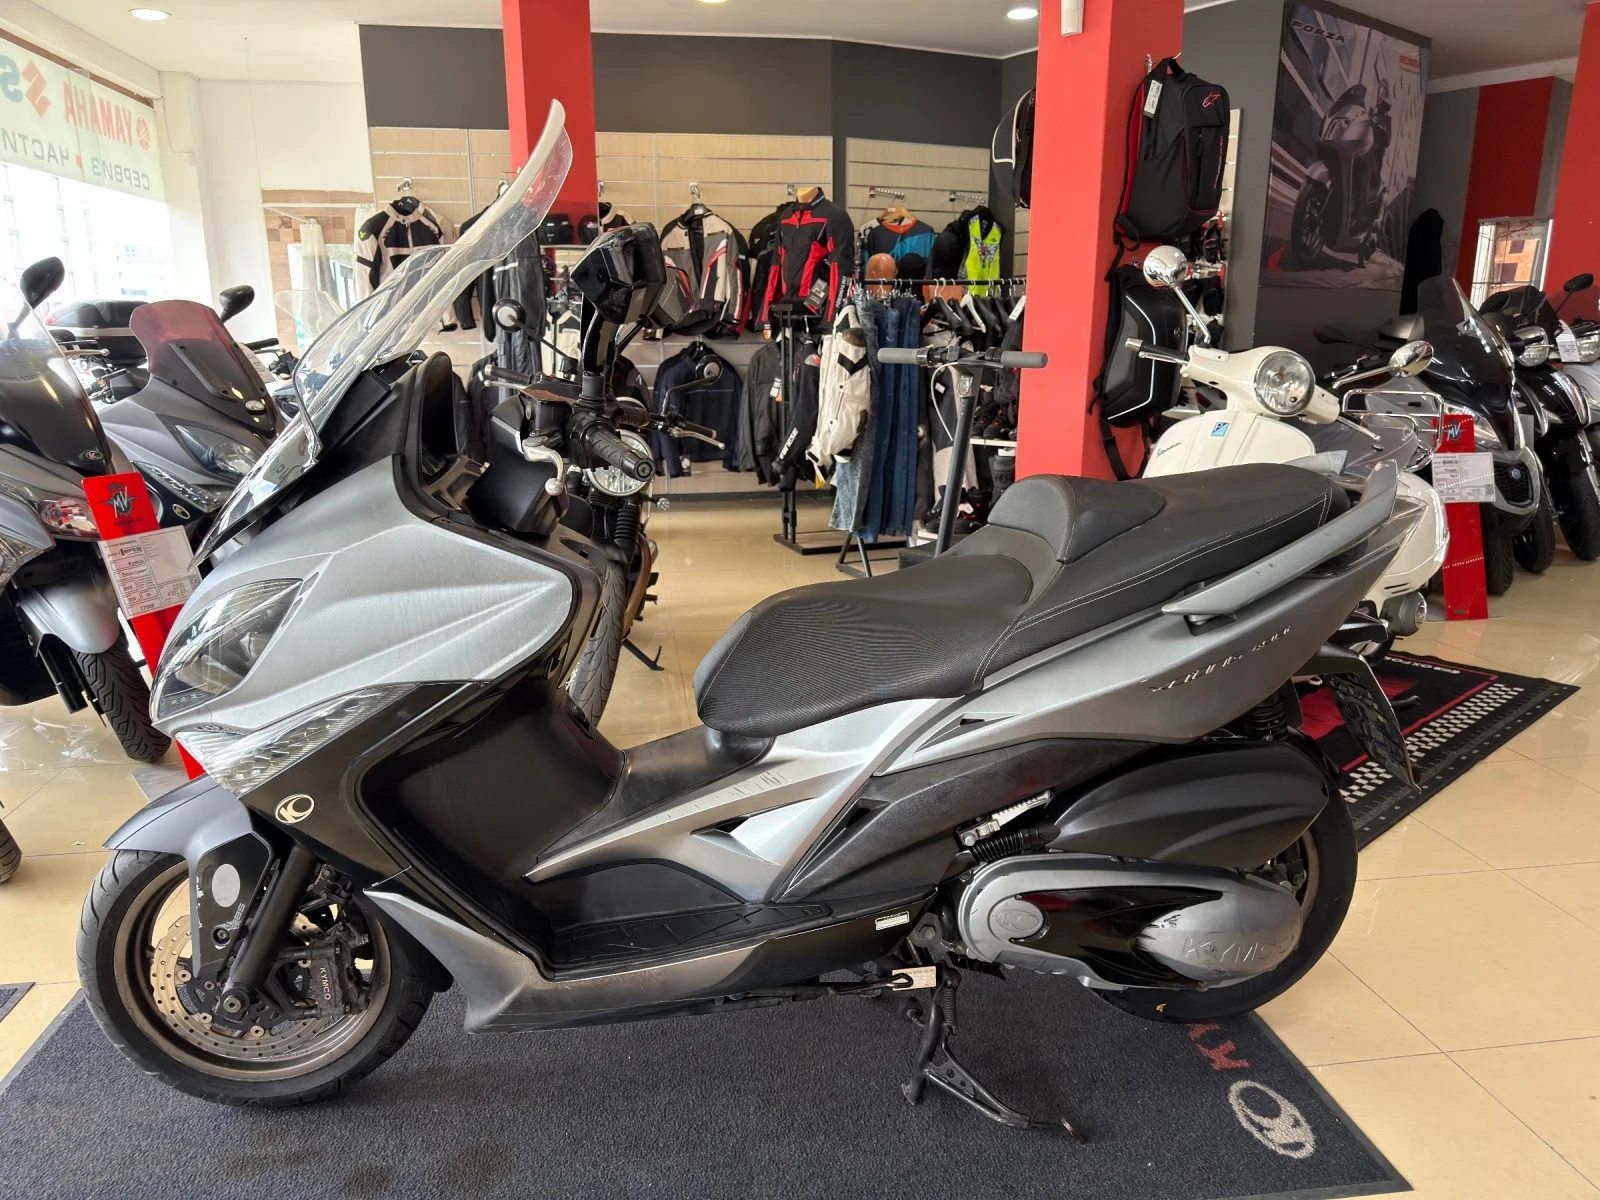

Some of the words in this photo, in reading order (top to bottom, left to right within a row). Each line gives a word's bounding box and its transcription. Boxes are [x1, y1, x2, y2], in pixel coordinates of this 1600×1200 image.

[1291, 19, 1346, 43] FORZA
[1399, 55, 1422, 70] HONDA
[320, 967, 332, 1000] KYMCO
